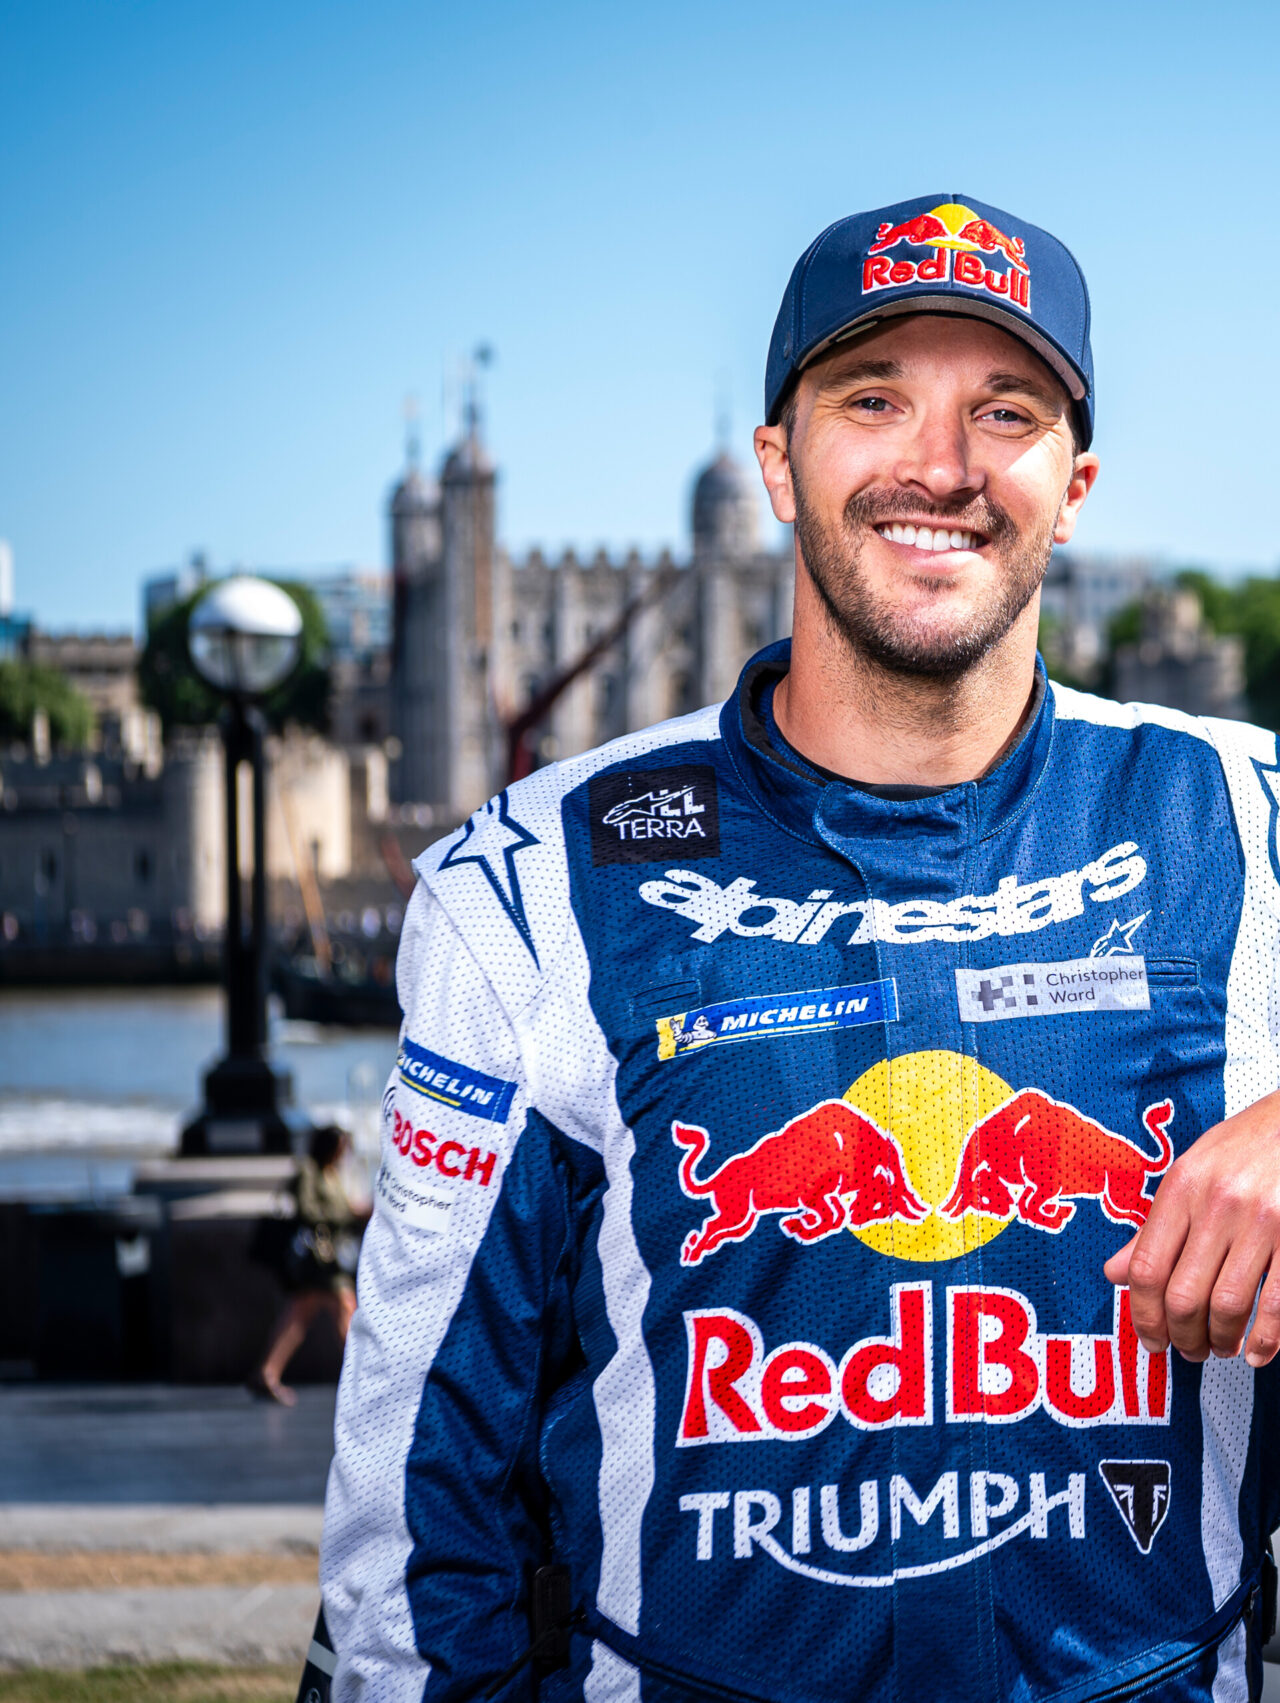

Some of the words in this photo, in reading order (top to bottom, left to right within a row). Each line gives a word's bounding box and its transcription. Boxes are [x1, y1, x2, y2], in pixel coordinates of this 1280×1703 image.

[862, 248, 950, 295] Red
[953, 250, 1032, 314] Bull
[613, 817, 706, 840] TERRA
[638, 841, 1148, 945] alpinestars
[1046, 966, 1144, 987] Christopher
[1049, 986, 1096, 1005] Ward
[721, 997, 870, 1032] MICHELIN
[391, 1109, 498, 1187] BOSCH
[676, 1281, 934, 1448] Red
[679, 1470, 1086, 1588] TRIUMPH
